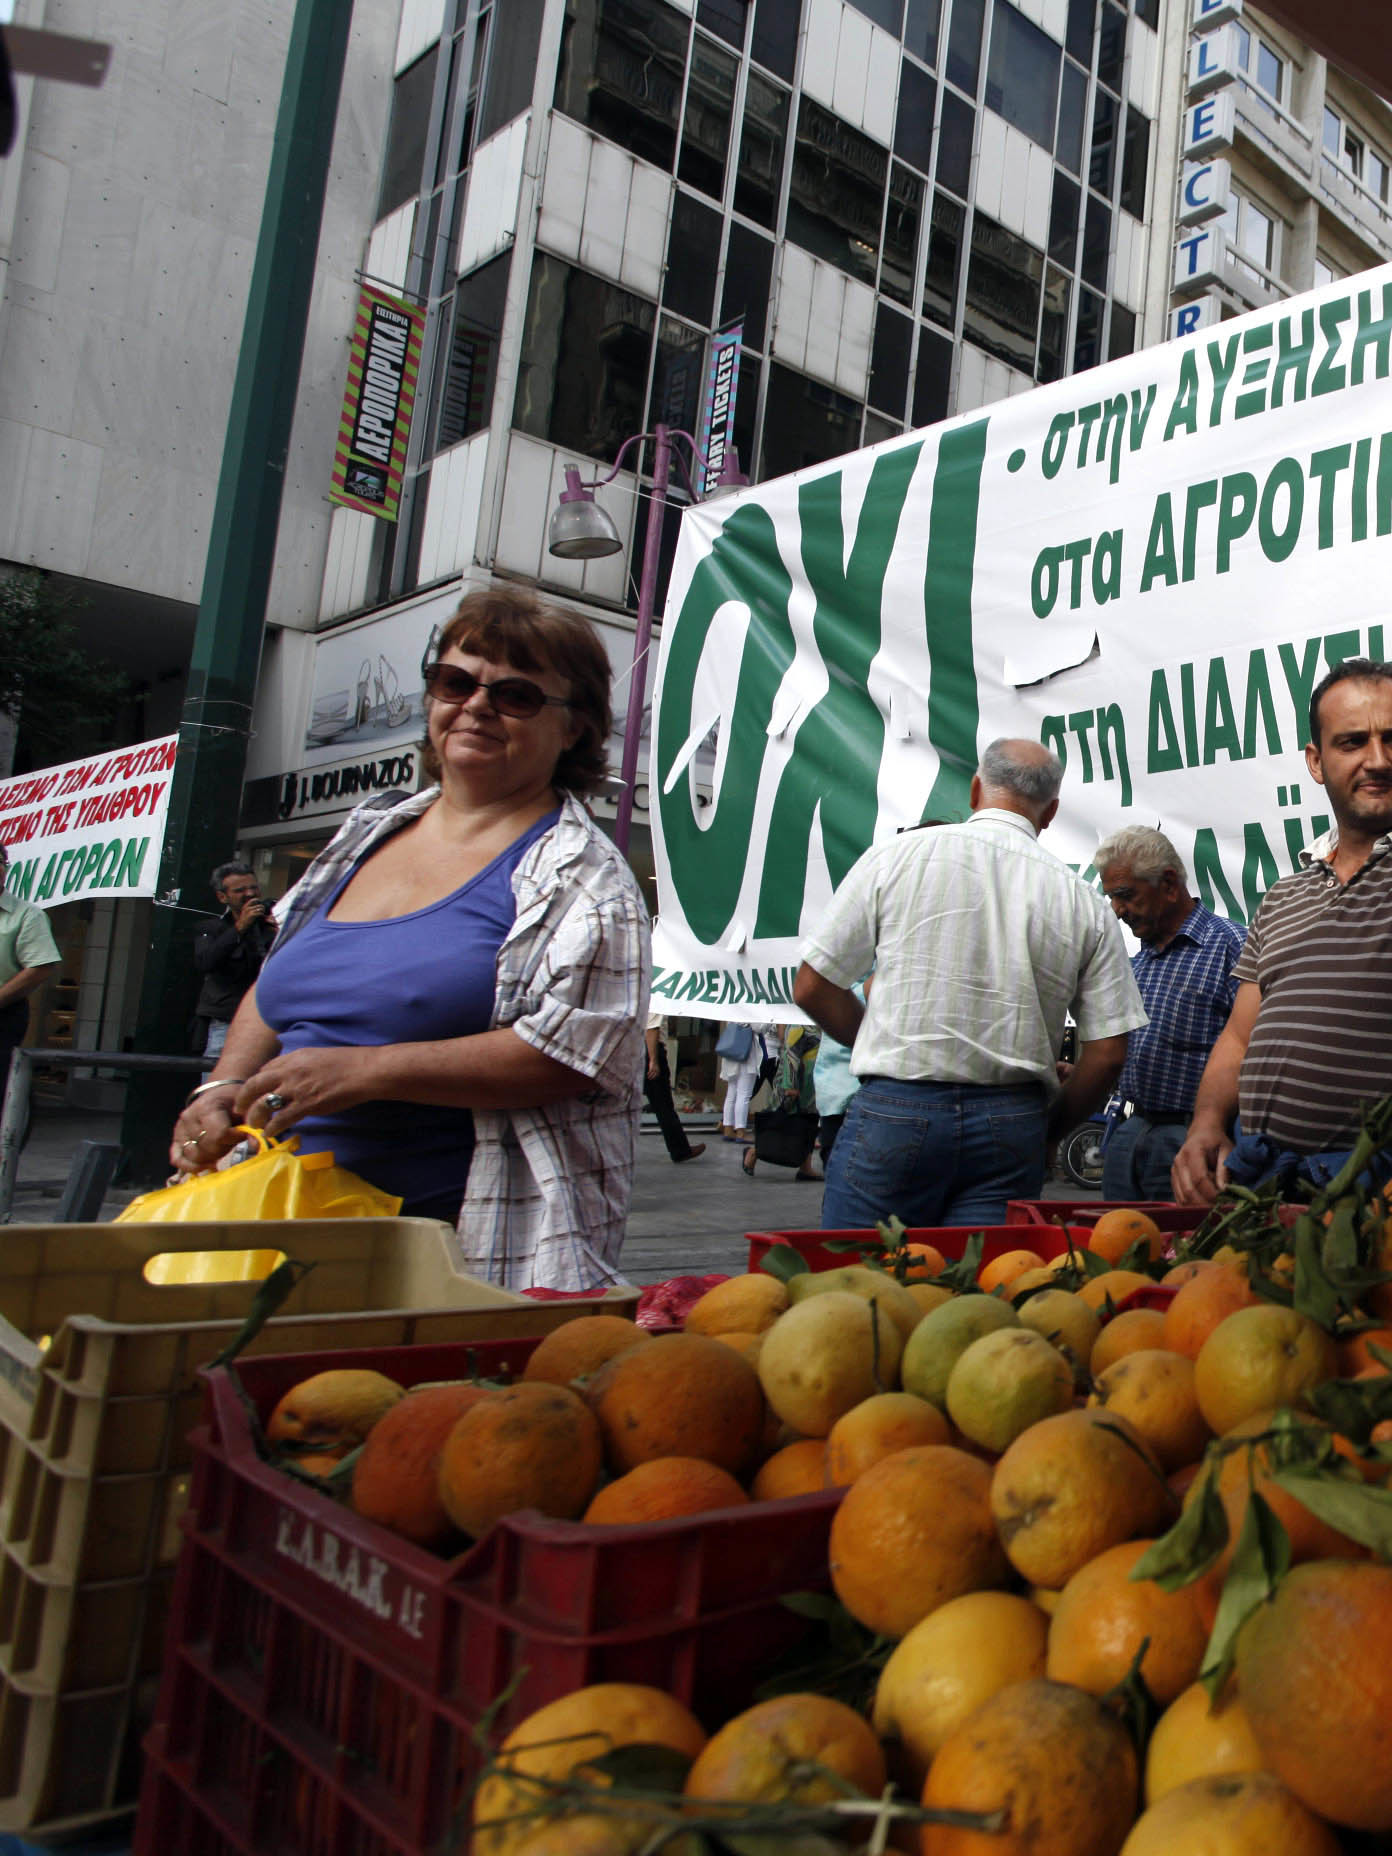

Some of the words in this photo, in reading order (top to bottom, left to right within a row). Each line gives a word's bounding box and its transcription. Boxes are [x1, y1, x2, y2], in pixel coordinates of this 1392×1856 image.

[1177, 0, 1221, 338] LECTR
[355, 319, 408, 464] ΑΕΡΟΠΟΡΙΚΑ
[712, 345, 734, 429] TICKETS
[1041, 384, 1158, 485] στην
[1031, 529, 1123, 619] στα
[656, 416, 990, 946] ΟΧΙ
[88, 741, 177, 789] ΑΓΡΟΤΩΝ
[311, 753, 414, 802] BOURNAZOS
[1041, 702, 1133, 807] στη
[40, 801, 78, 838] ΤΗΣ
[73, 781, 168, 830] ΥΠΑΙΘΡΟΥ
[33, 837, 152, 903] ΑΓΟΡΩΝ
[651, 966, 798, 1005] ΑΝΕΛΛΑΔΙ
